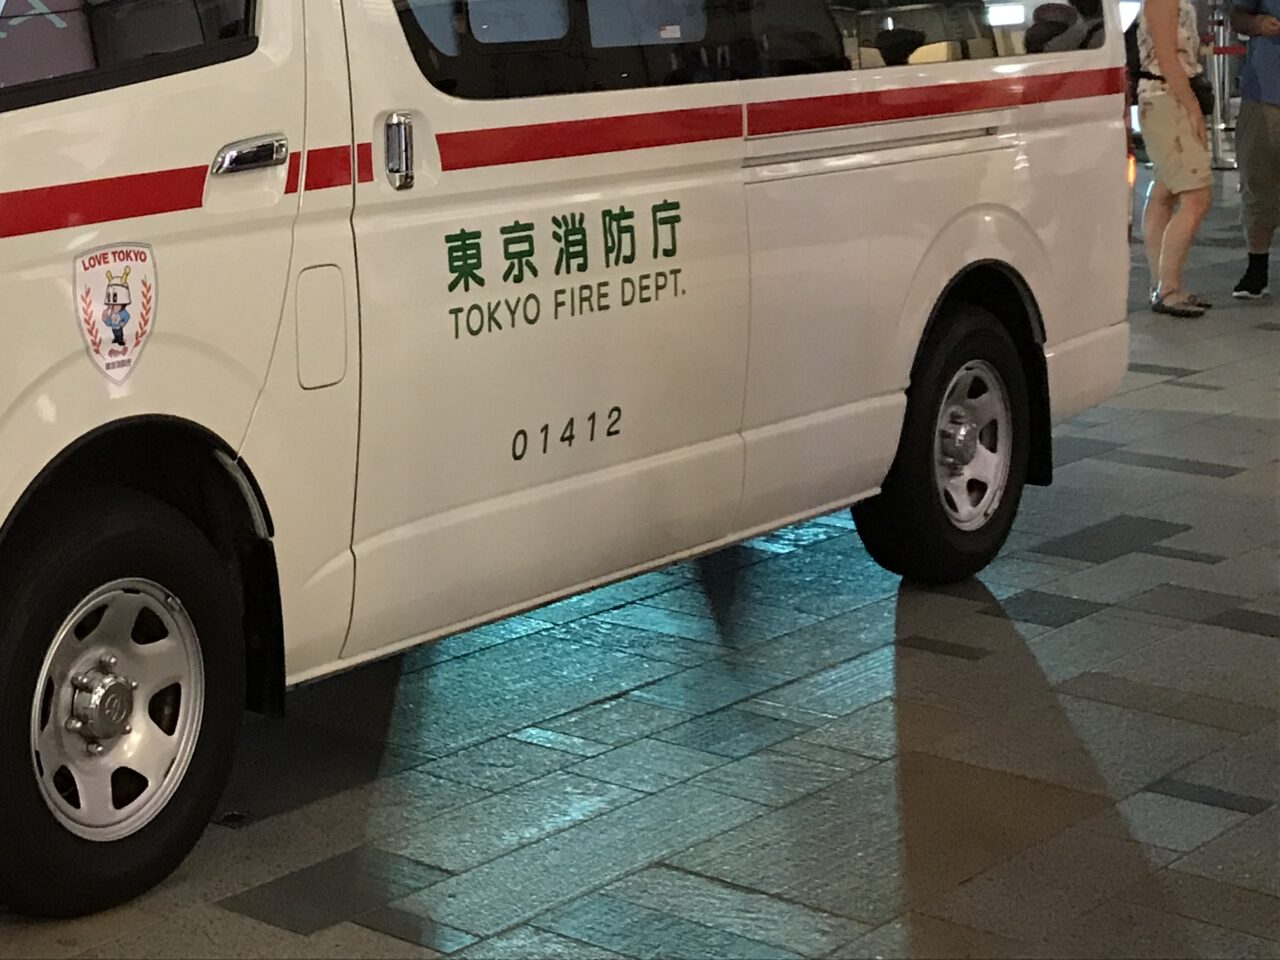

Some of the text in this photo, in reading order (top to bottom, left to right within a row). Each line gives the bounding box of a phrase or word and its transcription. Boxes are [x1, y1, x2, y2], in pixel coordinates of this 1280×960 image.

[82, 249, 147, 272] LOVE TOKYO
[445, 199, 682, 292] 東京消防庁
[449, 268, 686, 339] TOKYO FIRE DEPT.
[512, 406, 622, 461] 01412
